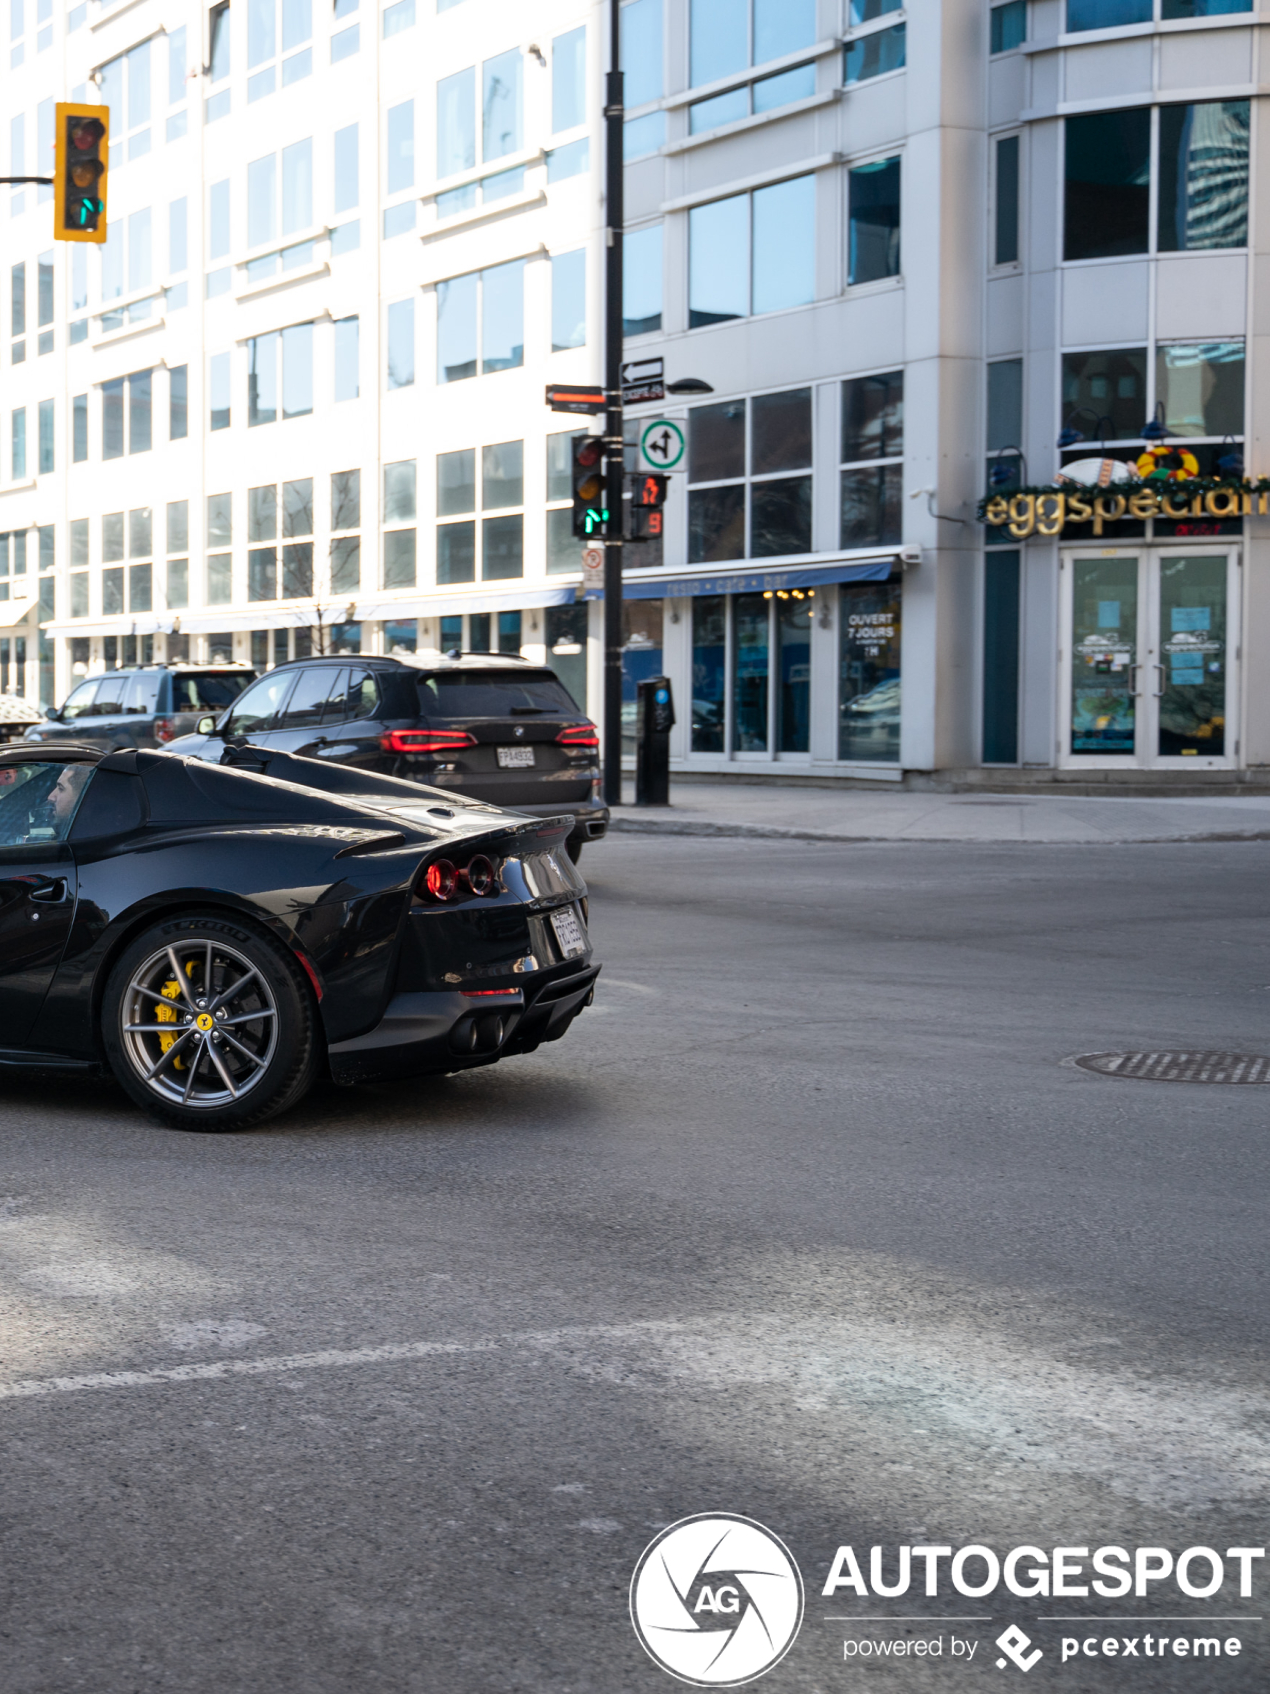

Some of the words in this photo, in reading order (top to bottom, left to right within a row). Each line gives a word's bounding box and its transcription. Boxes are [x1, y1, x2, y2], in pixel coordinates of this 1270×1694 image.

[649, 512, 662, 533] 9
[849, 613, 894, 626] OUVERT
[855, 626, 895, 638] JOURS
